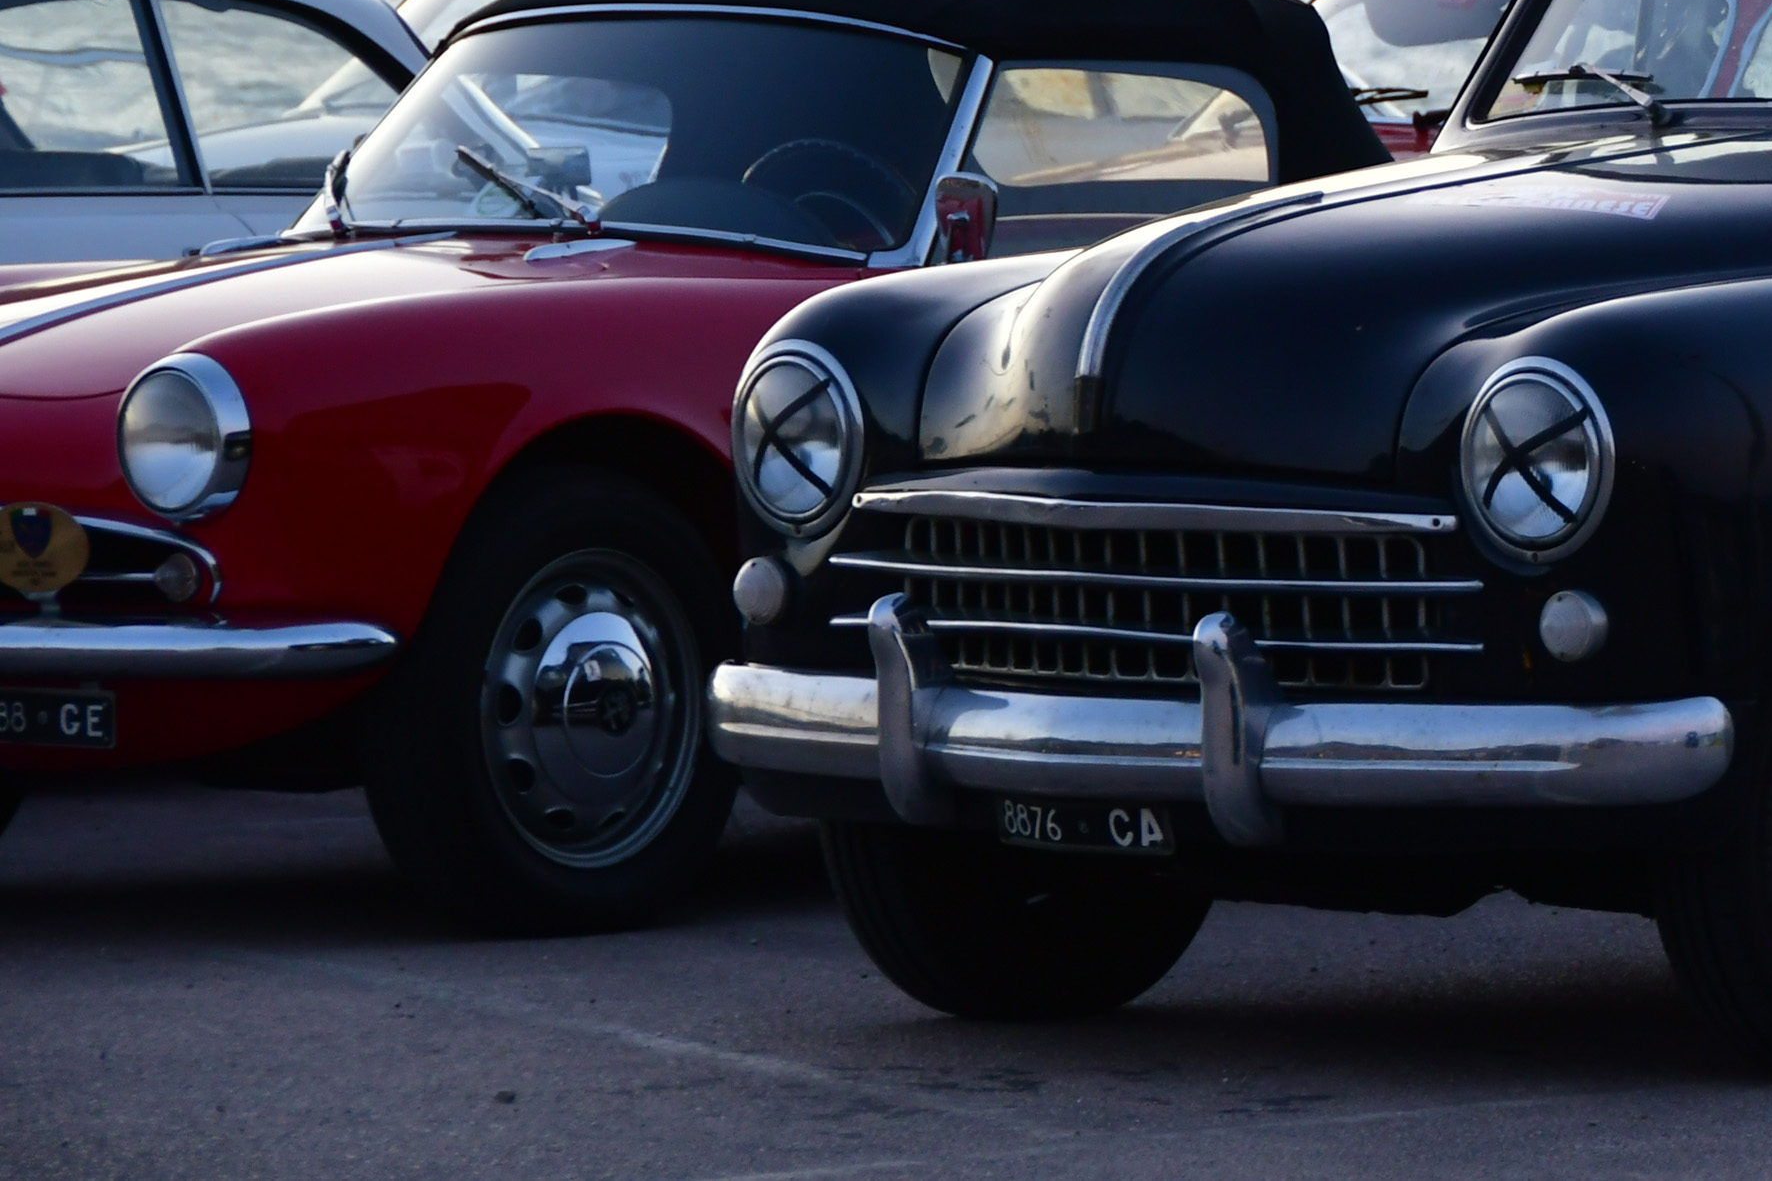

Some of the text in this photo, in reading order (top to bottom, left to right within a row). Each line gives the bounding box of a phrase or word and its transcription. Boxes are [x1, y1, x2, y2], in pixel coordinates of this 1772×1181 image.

[59, 703, 104, 737] GE
[1003, 798, 1165, 847] 8876 CA
